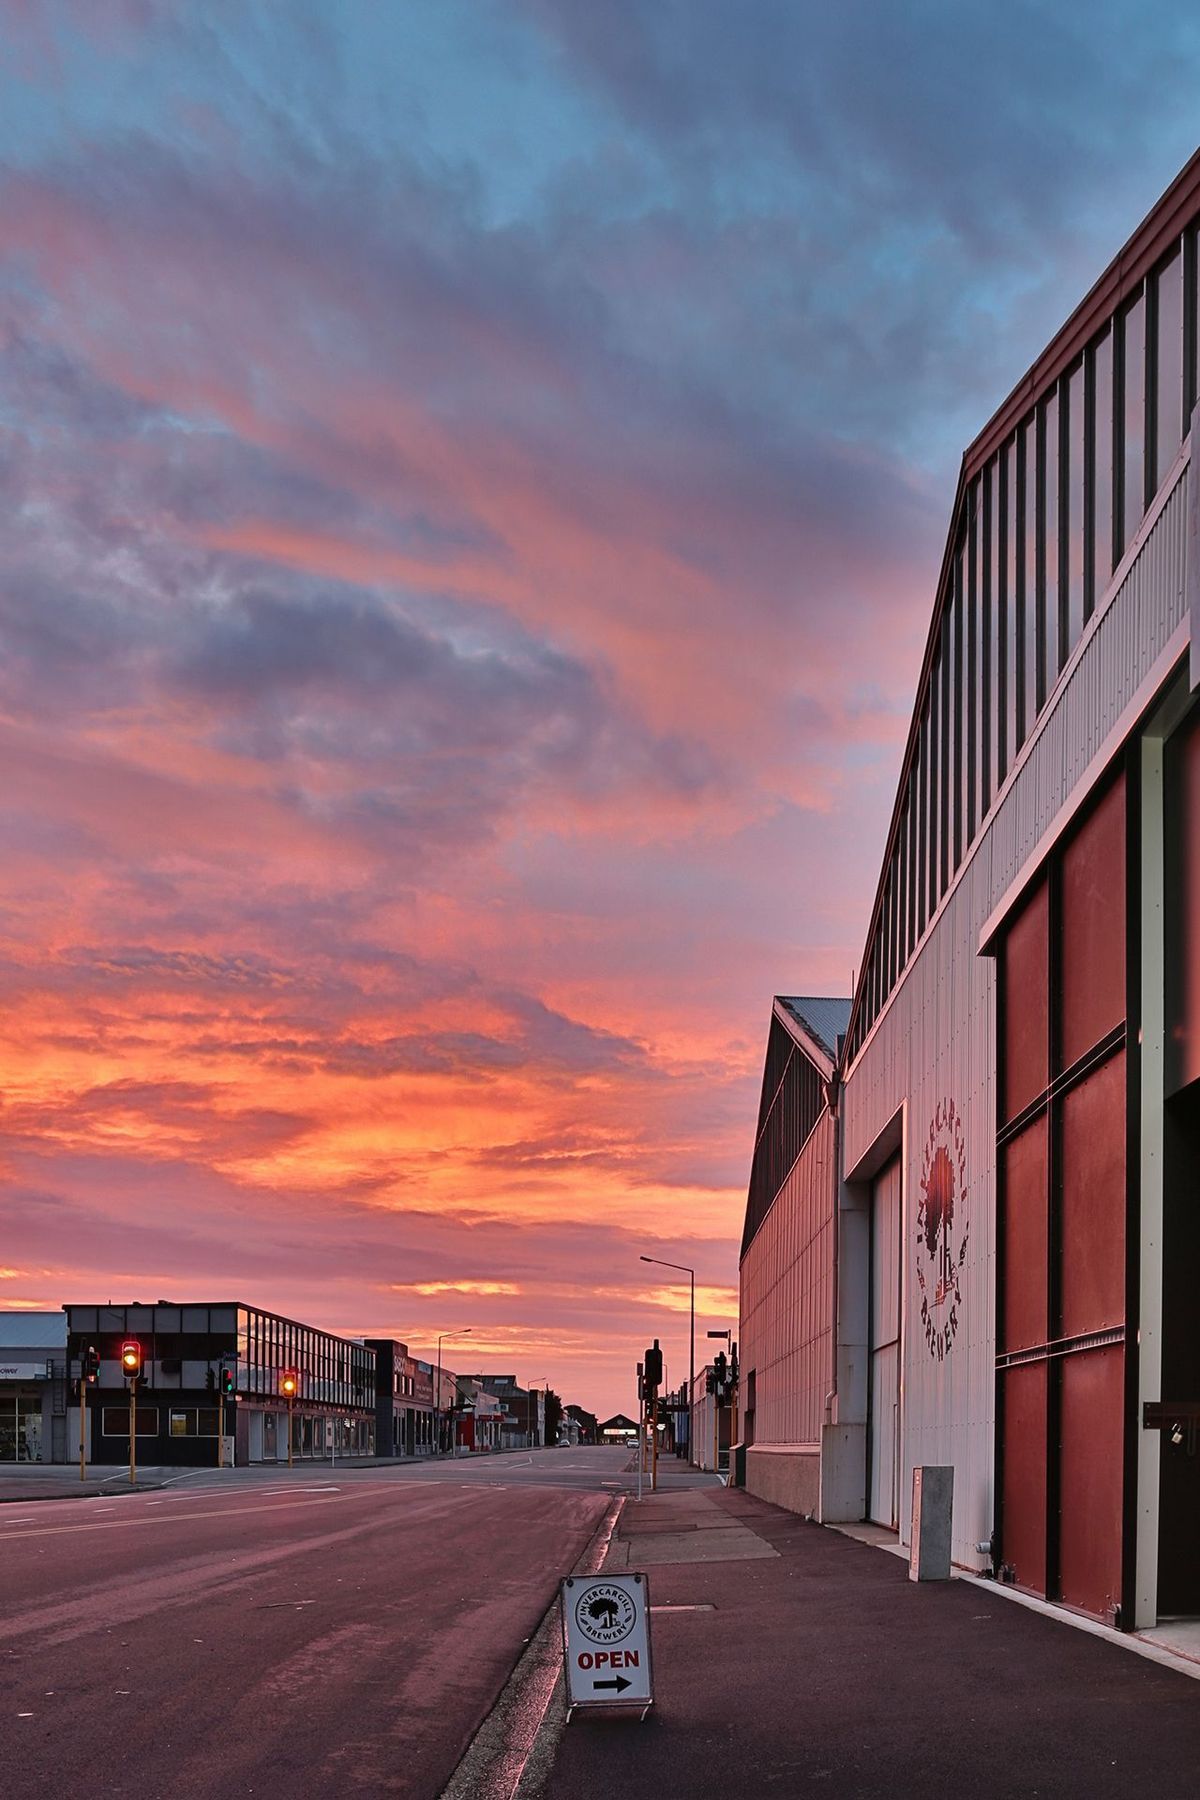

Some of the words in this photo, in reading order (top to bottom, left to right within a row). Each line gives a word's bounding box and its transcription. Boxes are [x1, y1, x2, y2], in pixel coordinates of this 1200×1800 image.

[921, 1278, 962, 1361] BREWERY
[580, 1588, 632, 1616] INVERCARGILL
[586, 1623, 628, 1641] BREWERY
[577, 1650, 640, 1670] OPEN
